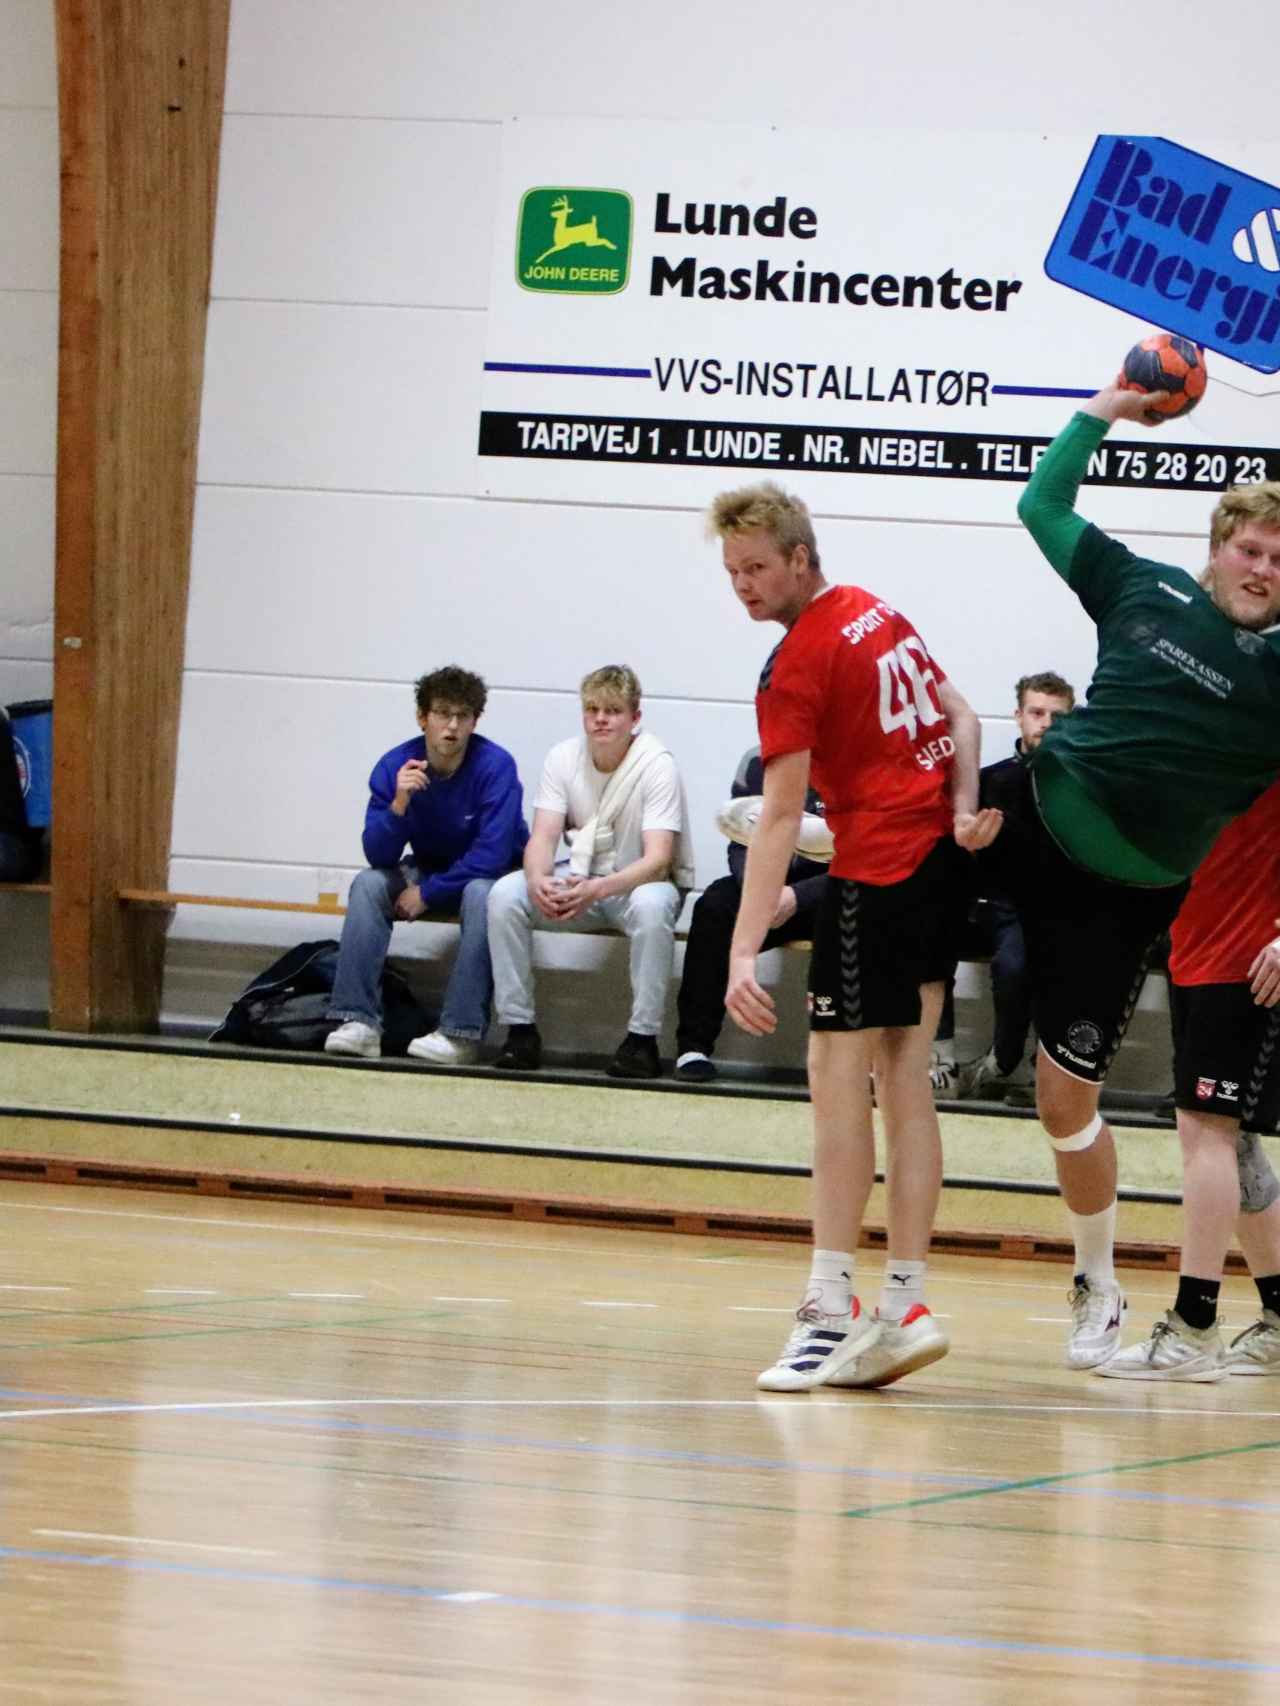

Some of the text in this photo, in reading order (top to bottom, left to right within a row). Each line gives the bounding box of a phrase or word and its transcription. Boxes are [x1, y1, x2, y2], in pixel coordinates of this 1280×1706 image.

[654, 192, 818, 240] Lunde
[1094, 138, 1233, 245] Bad
[524, 265, 619, 282] JOHN DEERE
[649, 256, 1023, 312] Maskincenter
[654, 357, 990, 407] VVS-INSTALLATØR
[517, 421, 641, 455] TARPVEJ
[686, 428, 781, 461] LUNDE
[803, 434, 850, 464] NR.
[859, 436, 953, 469] NEBEL
[977, 442, 1108, 477] TELN
[1115, 450, 1147, 479] 75
[1154, 451, 1188, 481] 28
[1194, 453, 1227, 483] 20
[1234, 455, 1267, 485] 23
